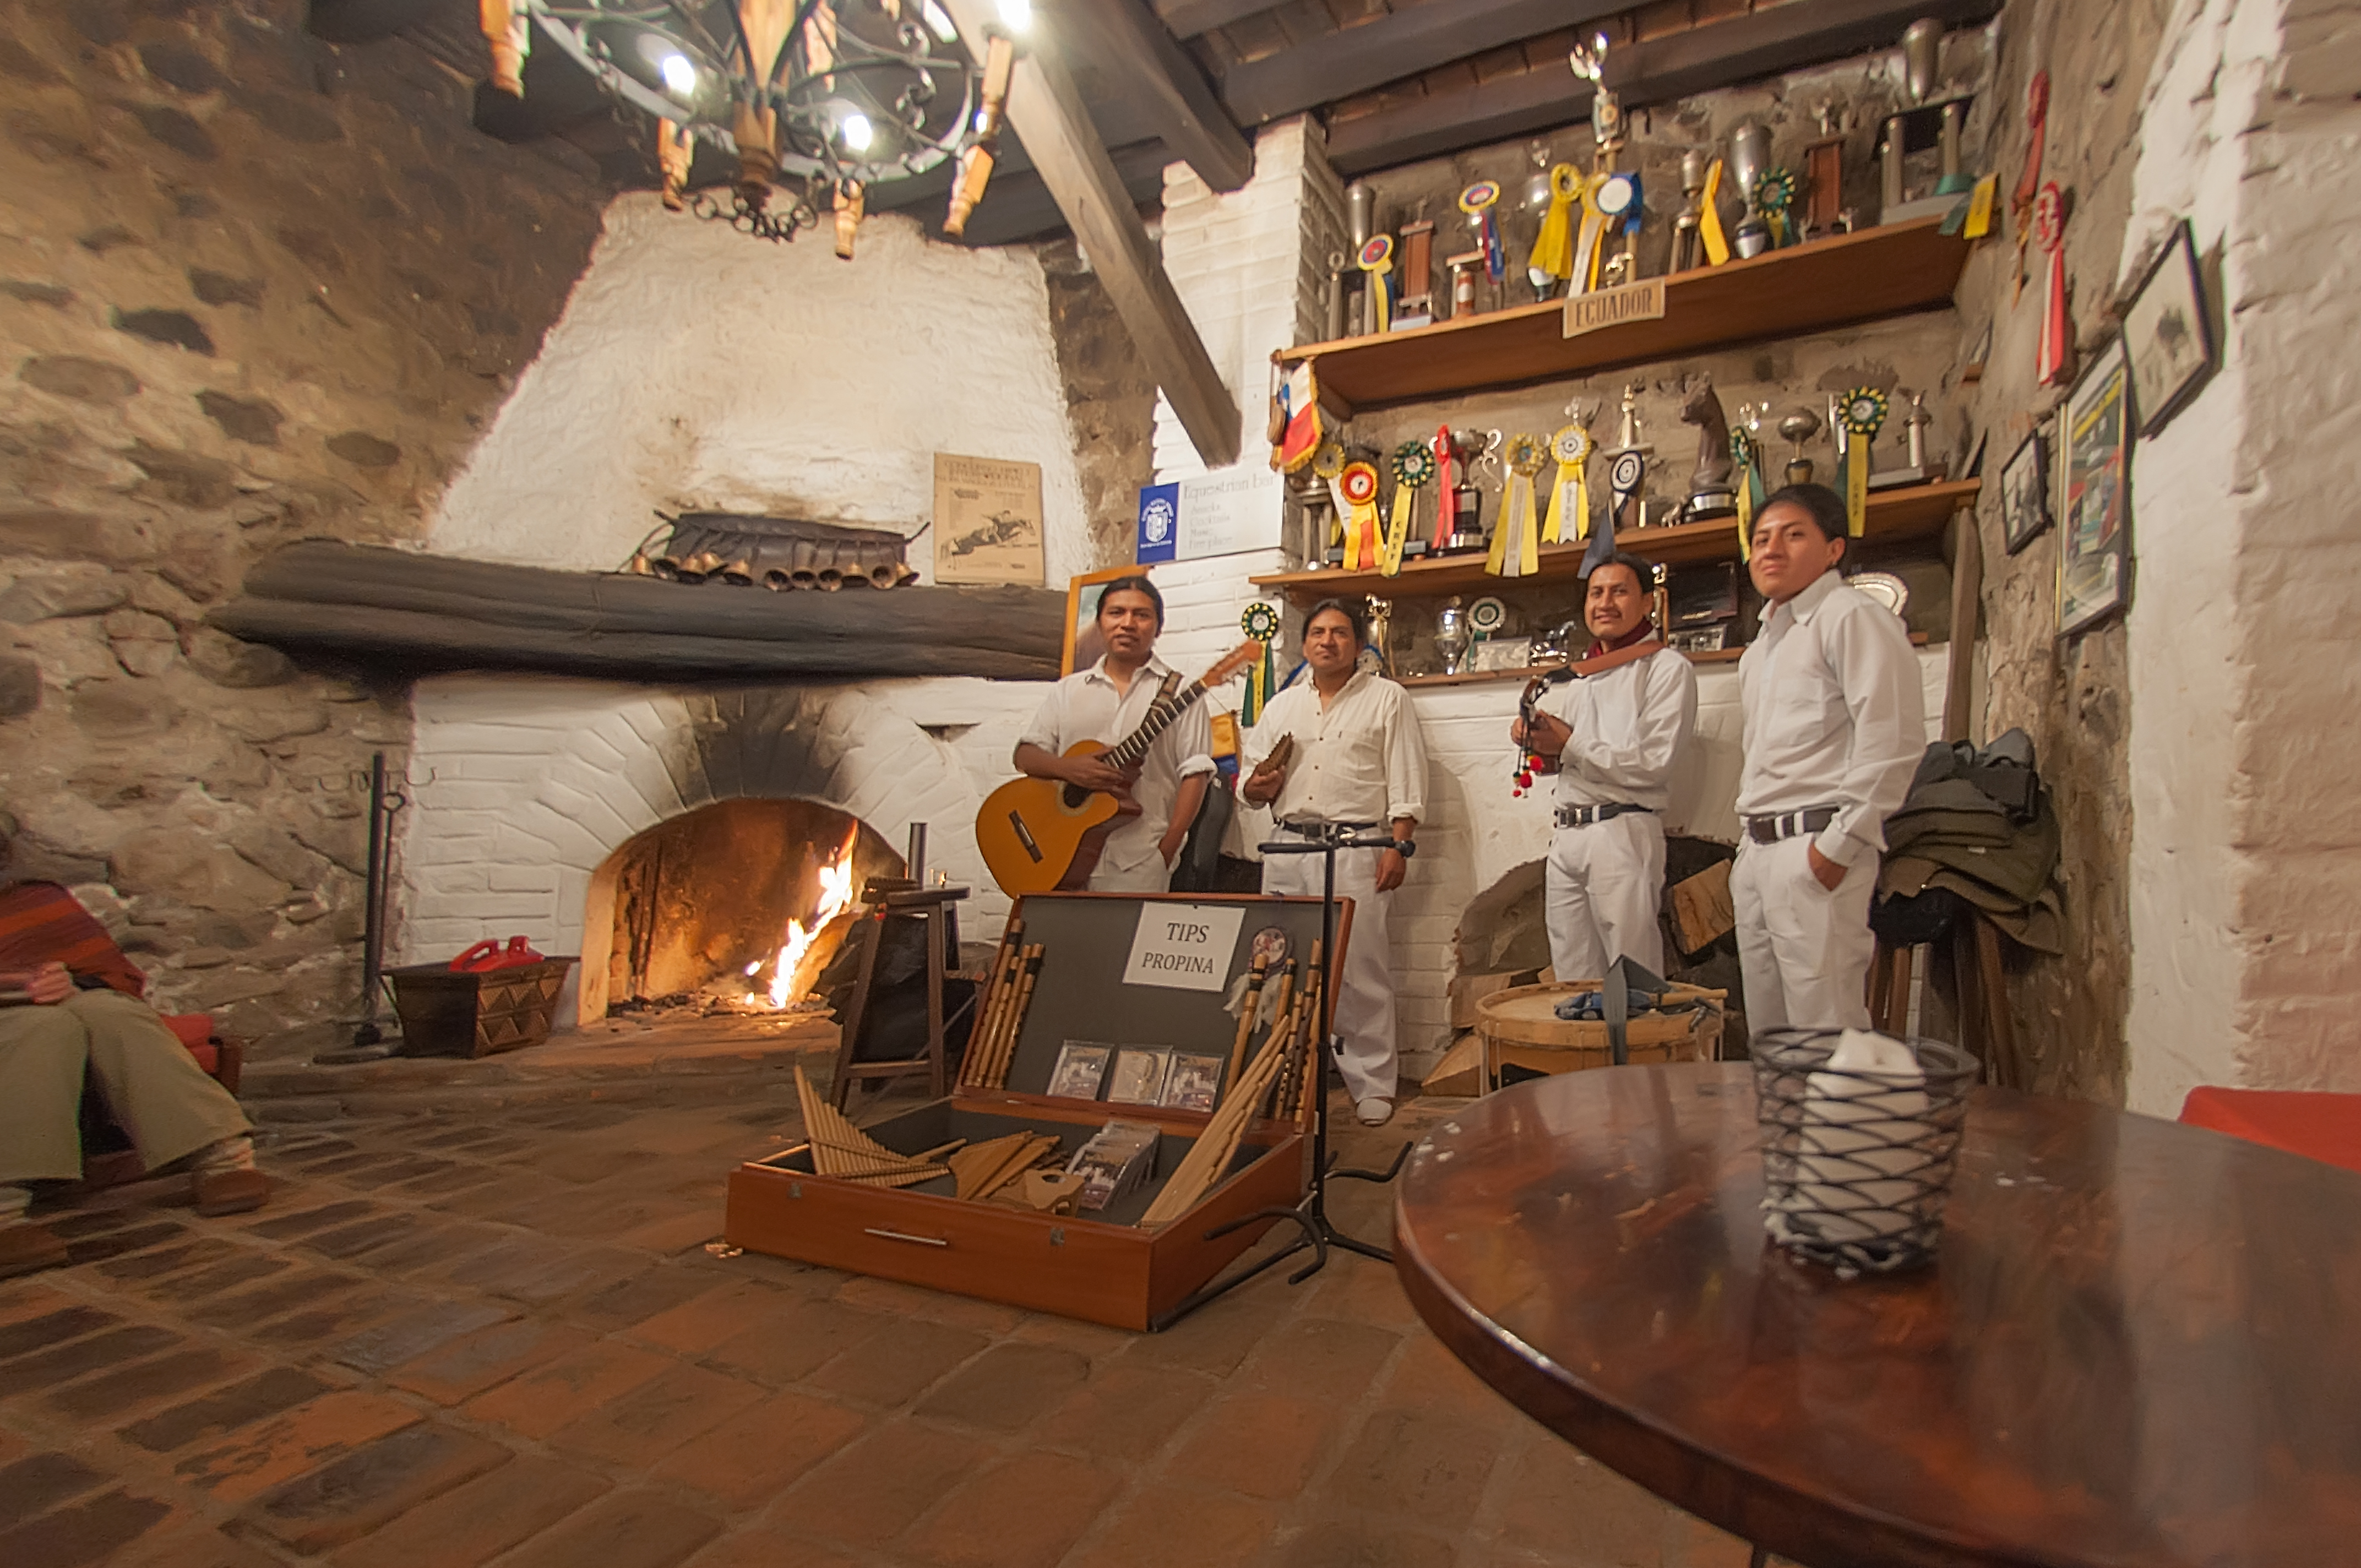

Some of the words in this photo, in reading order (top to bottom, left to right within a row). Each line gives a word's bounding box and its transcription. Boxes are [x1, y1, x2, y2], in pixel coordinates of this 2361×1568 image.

[1576, 287, 1652, 327] ECUADOR
[1184, 478, 1249, 503] Equestrian
[1253, 473, 1274, 488] bar
[1167, 922, 1210, 943] TIPS
[1141, 952, 1213, 974] PROPINA
